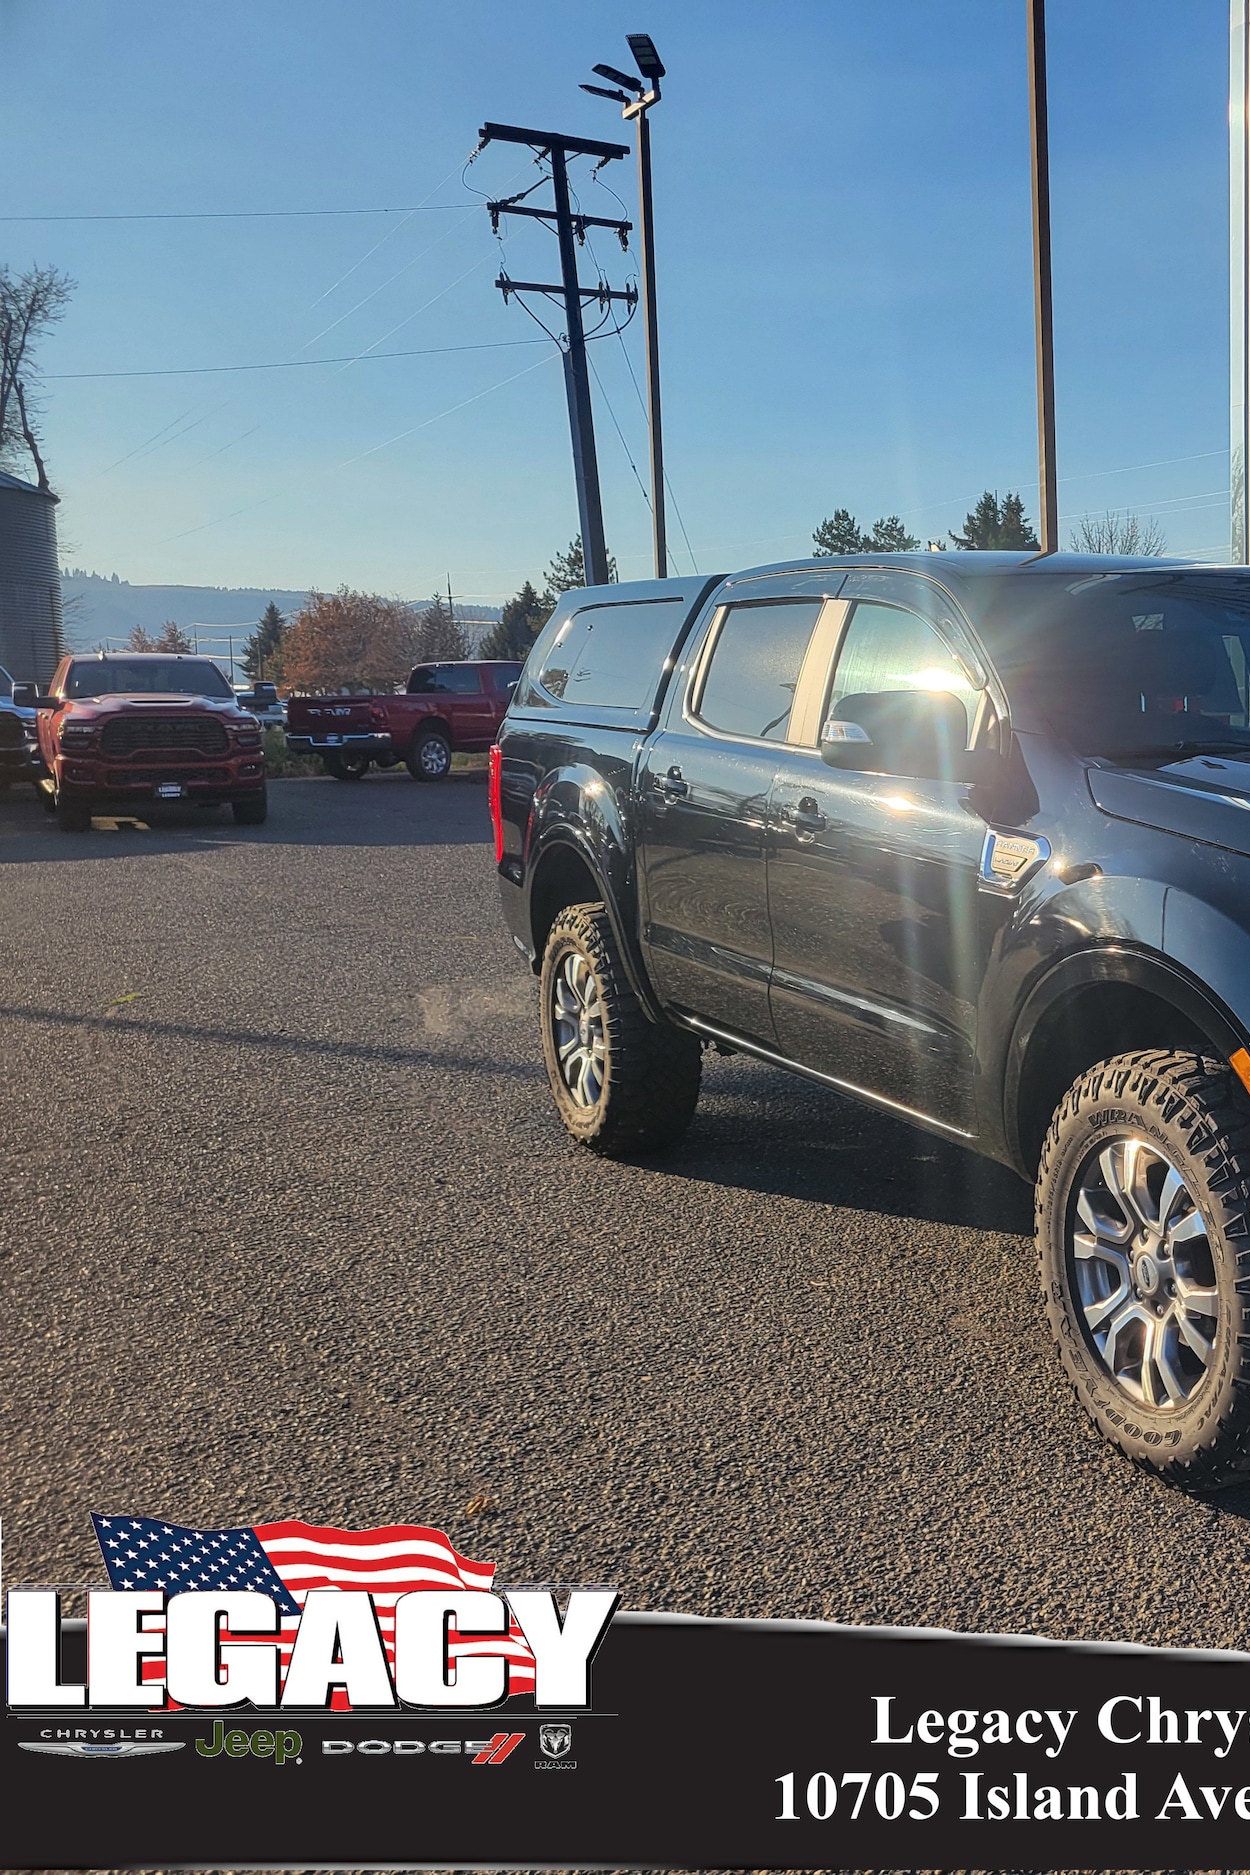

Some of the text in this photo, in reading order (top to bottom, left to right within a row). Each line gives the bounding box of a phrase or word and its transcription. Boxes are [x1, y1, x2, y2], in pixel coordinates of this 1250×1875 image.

[307, 707, 352, 716] RAM
[1087, 1107, 1225, 1264] WRANGLER
[1051, 1279, 1183, 1447] GOODYEAR
